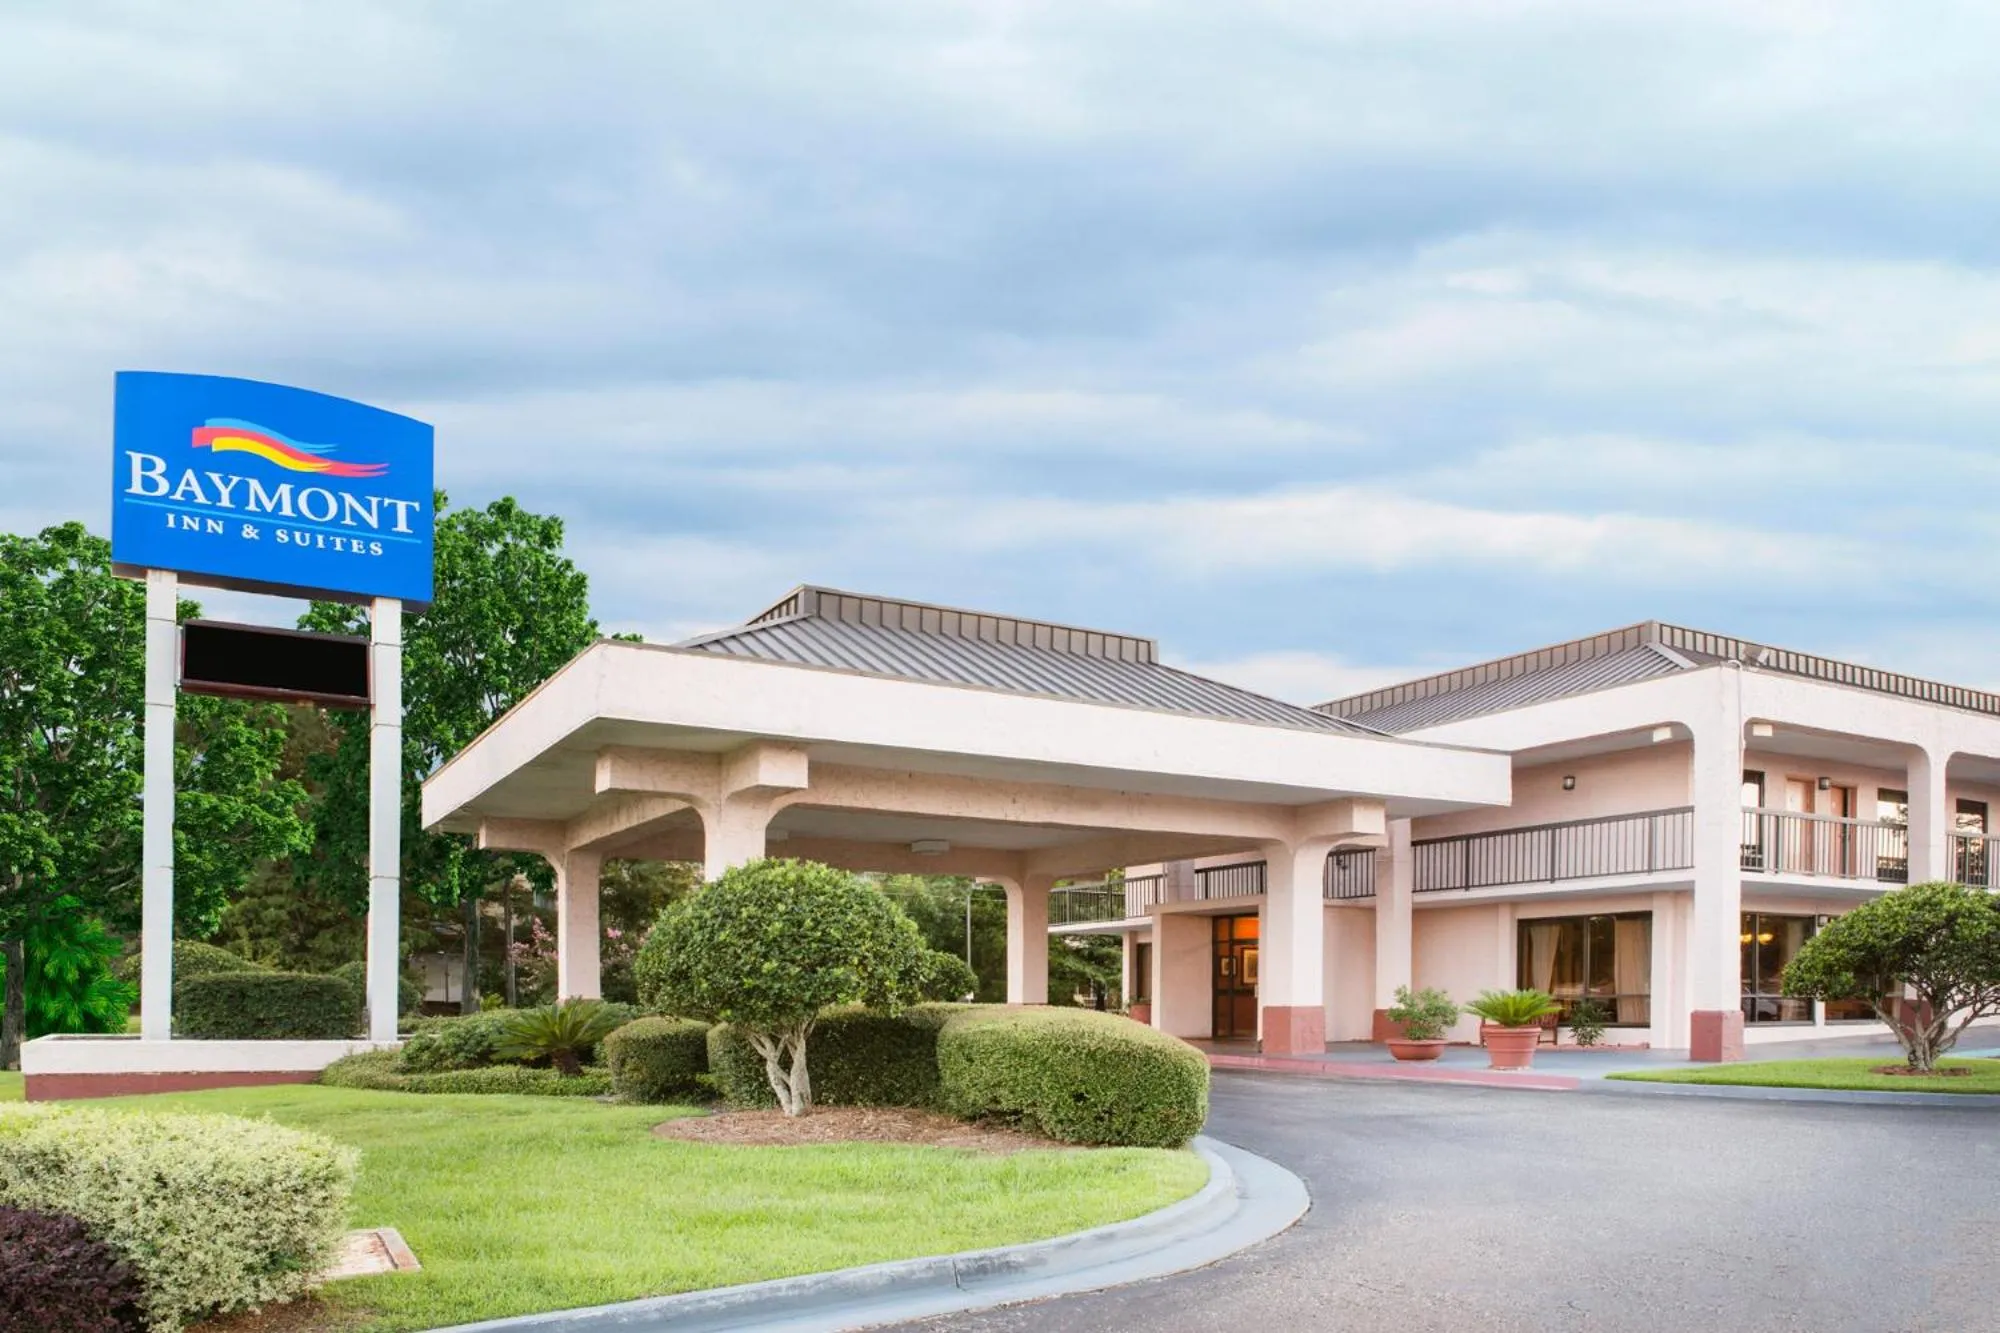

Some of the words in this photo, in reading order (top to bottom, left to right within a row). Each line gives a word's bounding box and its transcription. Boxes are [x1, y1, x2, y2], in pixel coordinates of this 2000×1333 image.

[125, 450, 420, 533] BAYMONT
[166, 513, 224, 534] INN
[241, 523, 260, 540] &
[276, 529, 383, 556] SUITES
